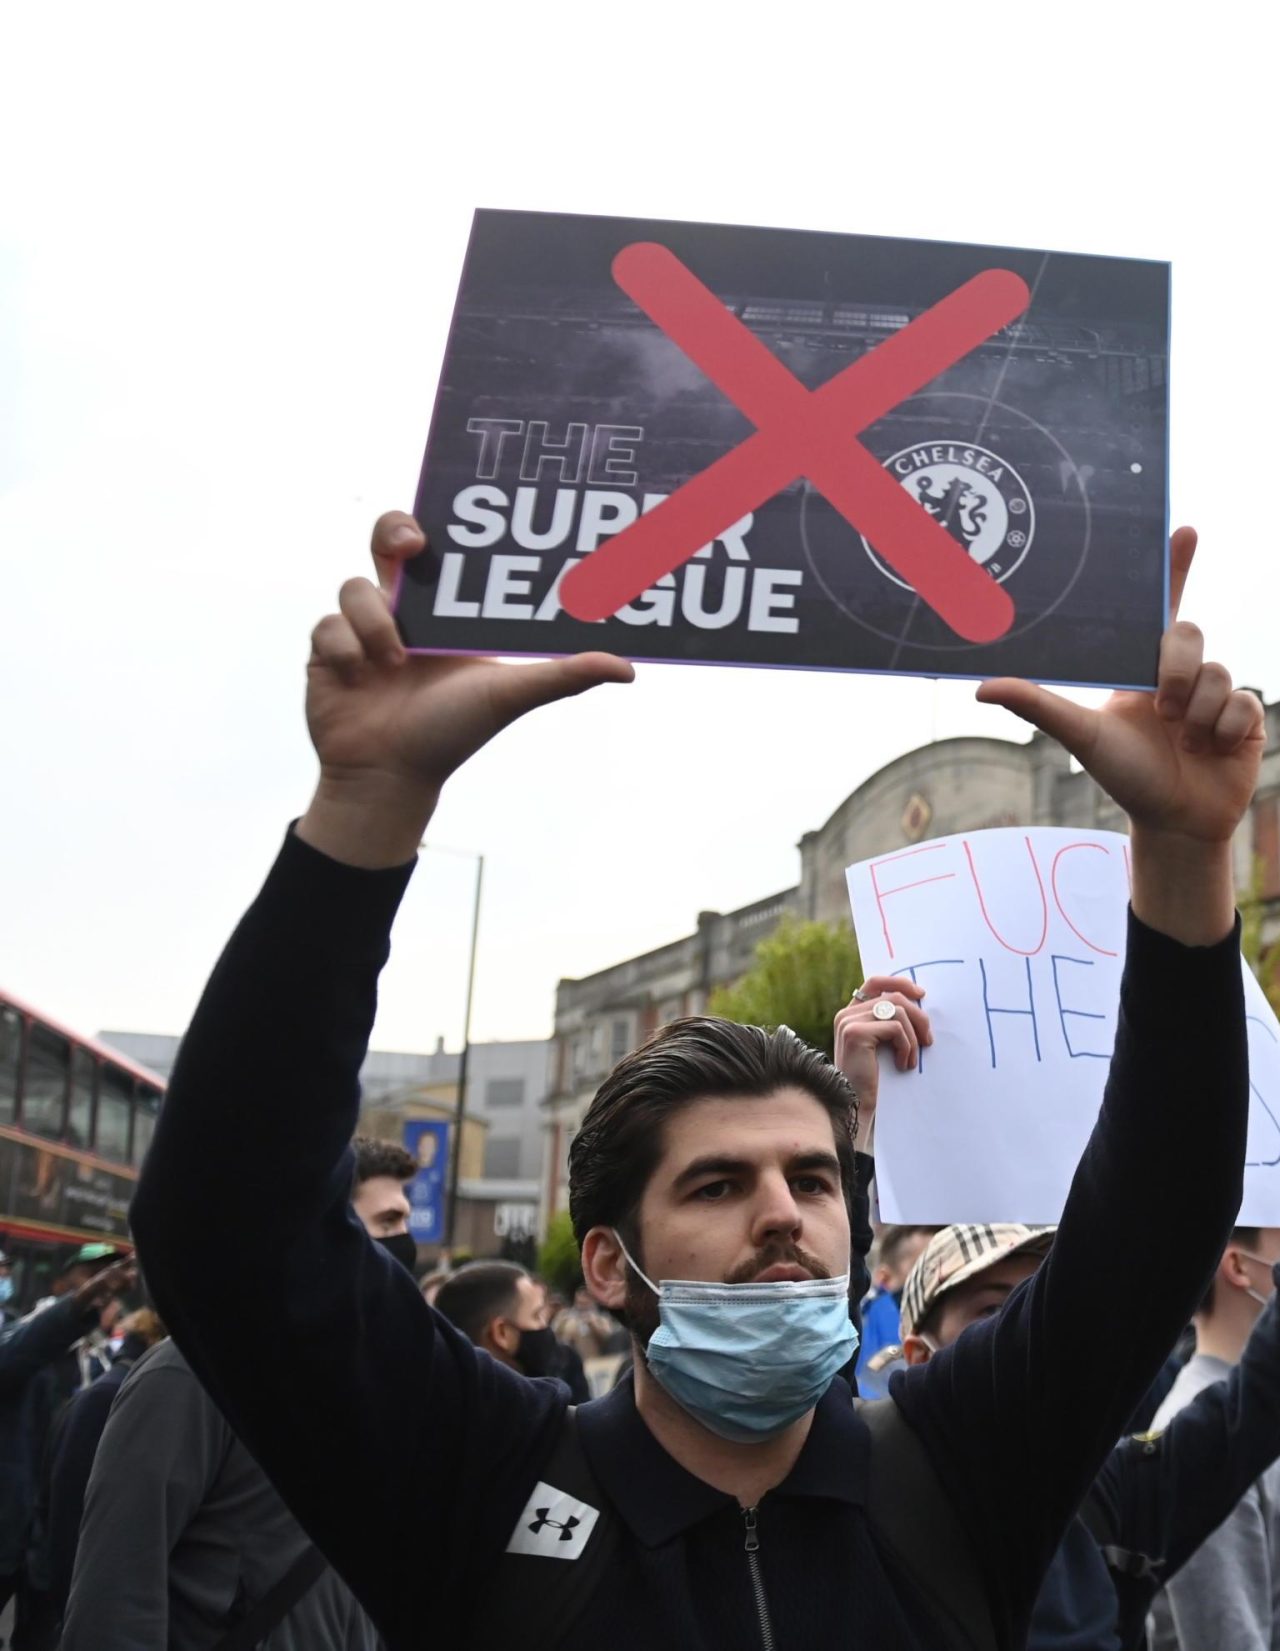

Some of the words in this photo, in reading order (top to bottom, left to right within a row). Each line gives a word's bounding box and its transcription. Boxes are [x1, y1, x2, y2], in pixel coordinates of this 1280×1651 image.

[467, 418, 644, 486] THE
[895, 447, 1005, 482] CHELSEA
[446, 484, 754, 561] SUPR
[870, 835, 1132, 958] FUC
[890, 954, 1112, 1074] THE
